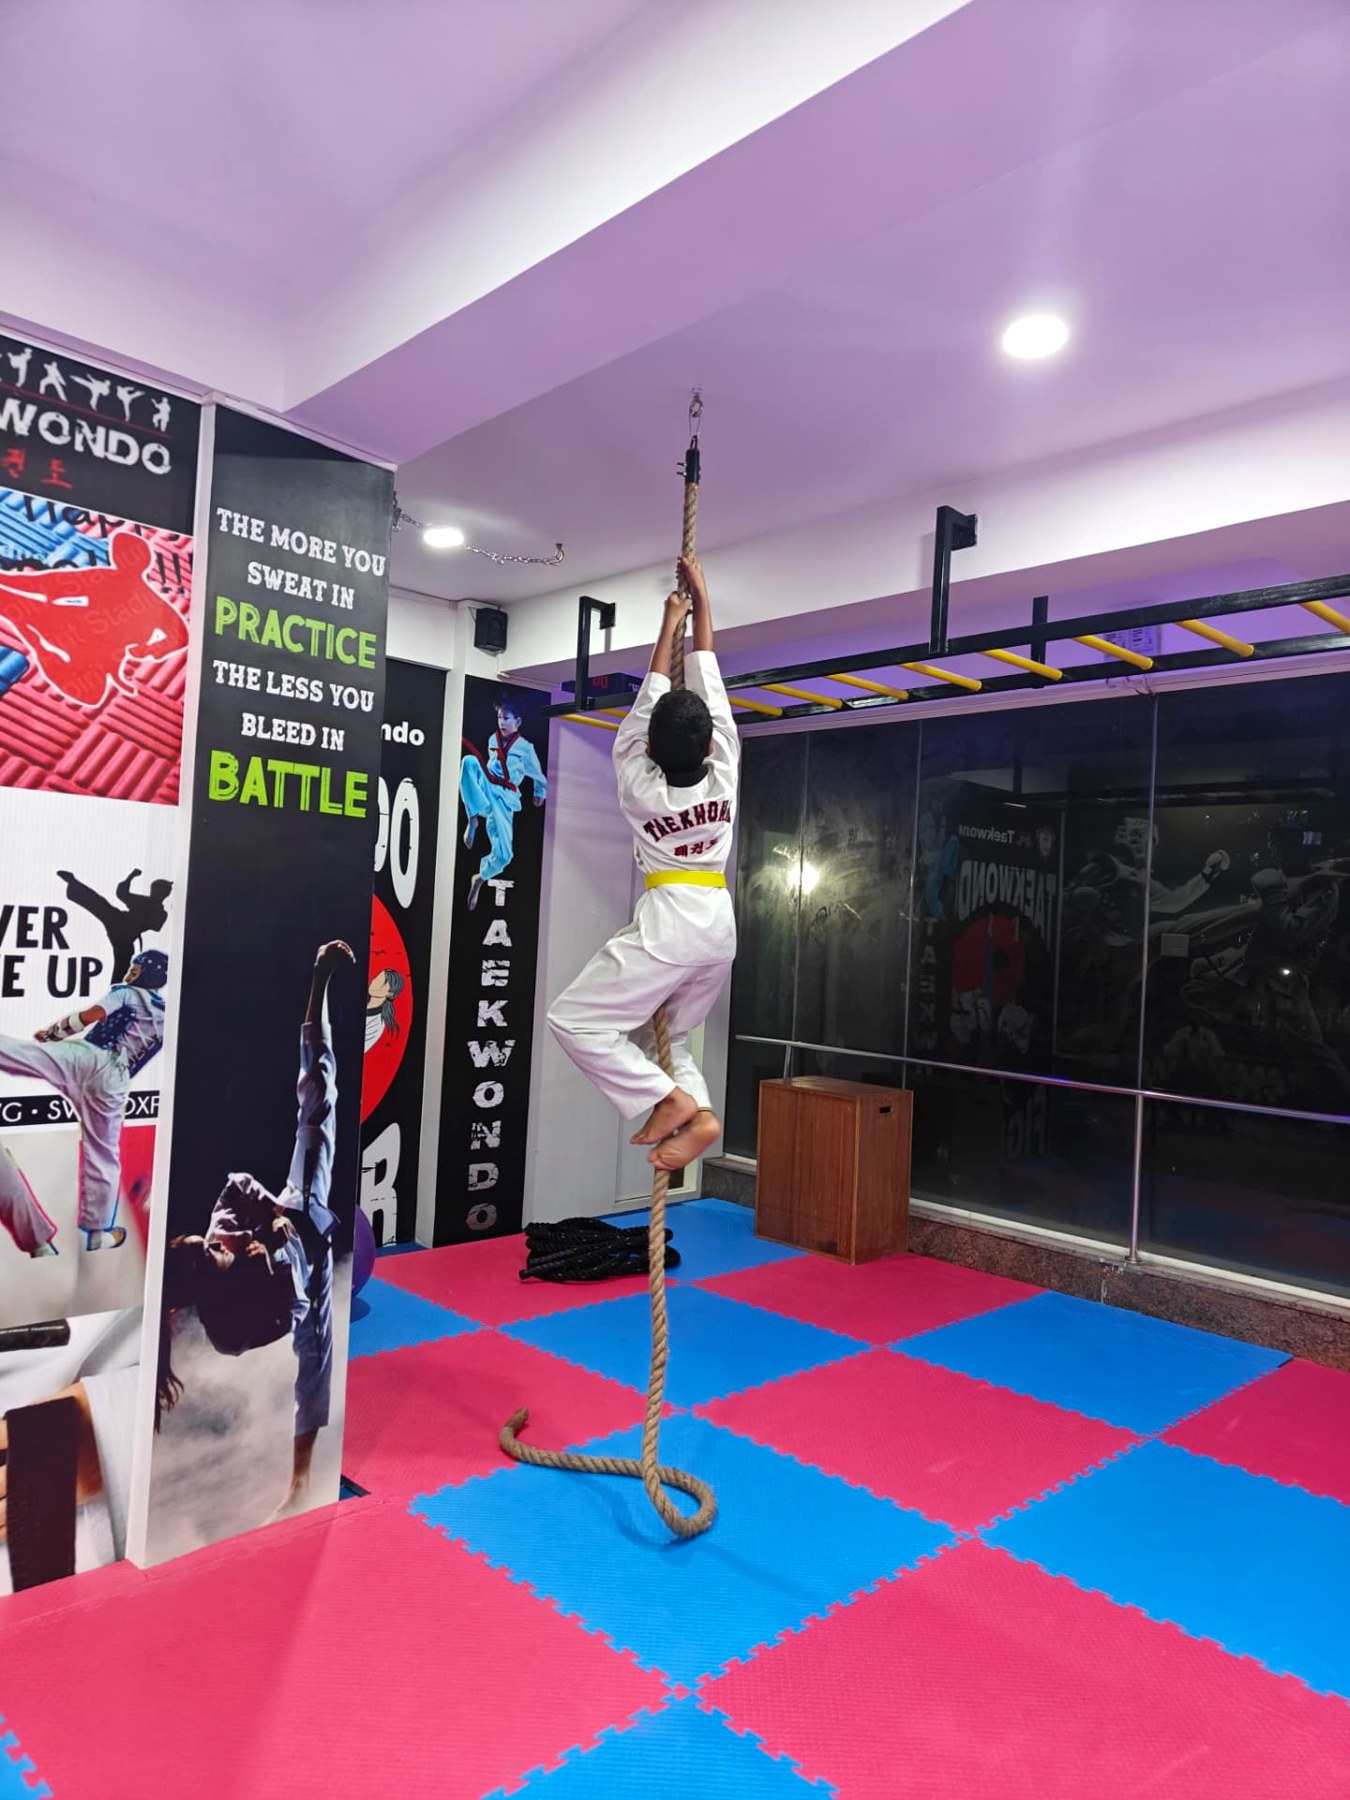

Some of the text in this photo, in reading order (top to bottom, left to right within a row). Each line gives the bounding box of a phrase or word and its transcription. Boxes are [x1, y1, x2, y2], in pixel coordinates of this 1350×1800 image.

[216, 507, 265, 543] THE
[269, 524, 337, 564] MORE
[341, 545, 386, 577] YOU
[247, 561, 355, 610] SWEAT IN
[214, 595, 377, 670] PRACTICE
[212, 659, 375, 712] THE LESS YOU
[240, 712, 345, 752] BLEED IN
[381, 721, 425, 746] ndo
[208, 749, 369, 818] BATTLE
[47, 955, 103, 998] UP
[465, 878, 516, 1231] TAEKWONDO
[0, 1102, 22, 1123] G
[360, 1122, 401, 1248] R
